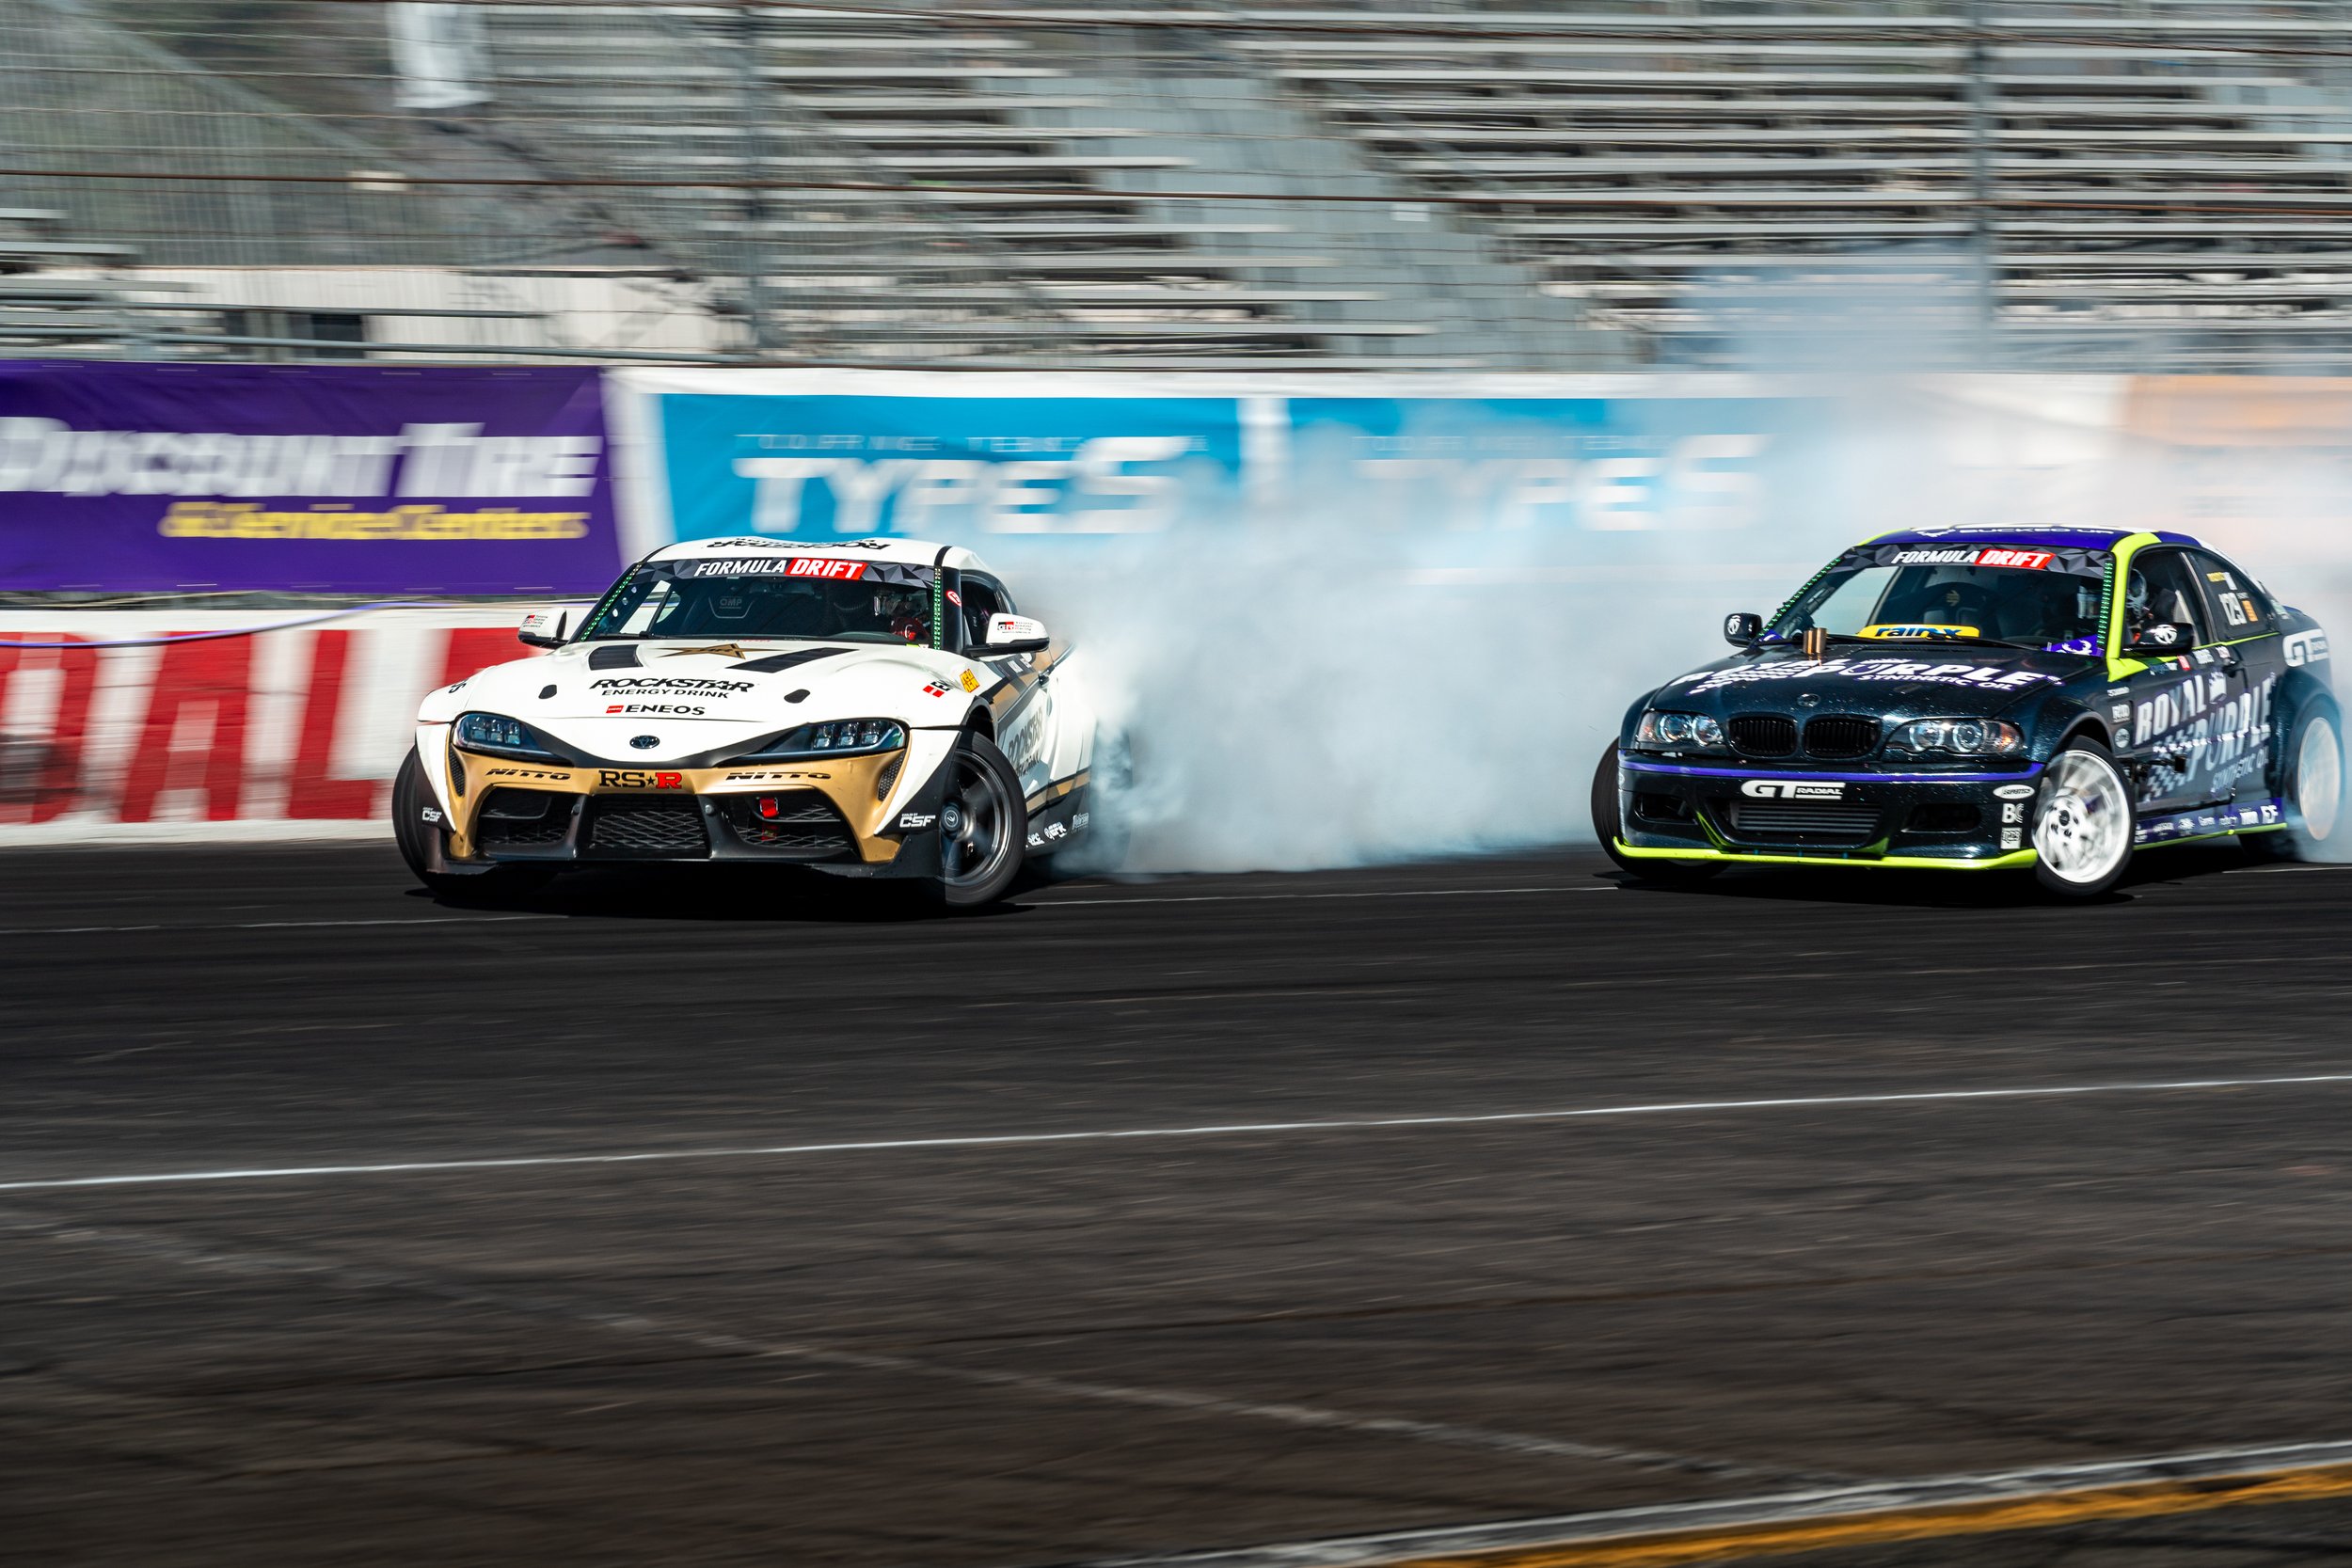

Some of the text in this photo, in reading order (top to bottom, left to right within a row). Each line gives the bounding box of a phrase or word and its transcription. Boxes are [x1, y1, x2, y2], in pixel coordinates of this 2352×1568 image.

[1891, 549, 2052, 567] FORMULA DRIFT
[693, 558, 863, 579] FORMULA DRIFT
[1792, 661, 2047, 686] PURPLE
[589, 678, 755, 693] ROCKSTAR
[1858, 675, 2012, 691] SYNTHETIC OIL
[601, 689, 729, 699] ENERGY DRINK
[625, 705, 706, 716] ENEOS
[2135, 674, 2207, 746] ROYAL
[485, 768, 571, 781] NITTO
[725, 771, 832, 781] NITTO
[1796, 787, 1844, 796] RADIAL
[422, 810, 442, 823] CSF
[899, 815, 936, 828] CSF
